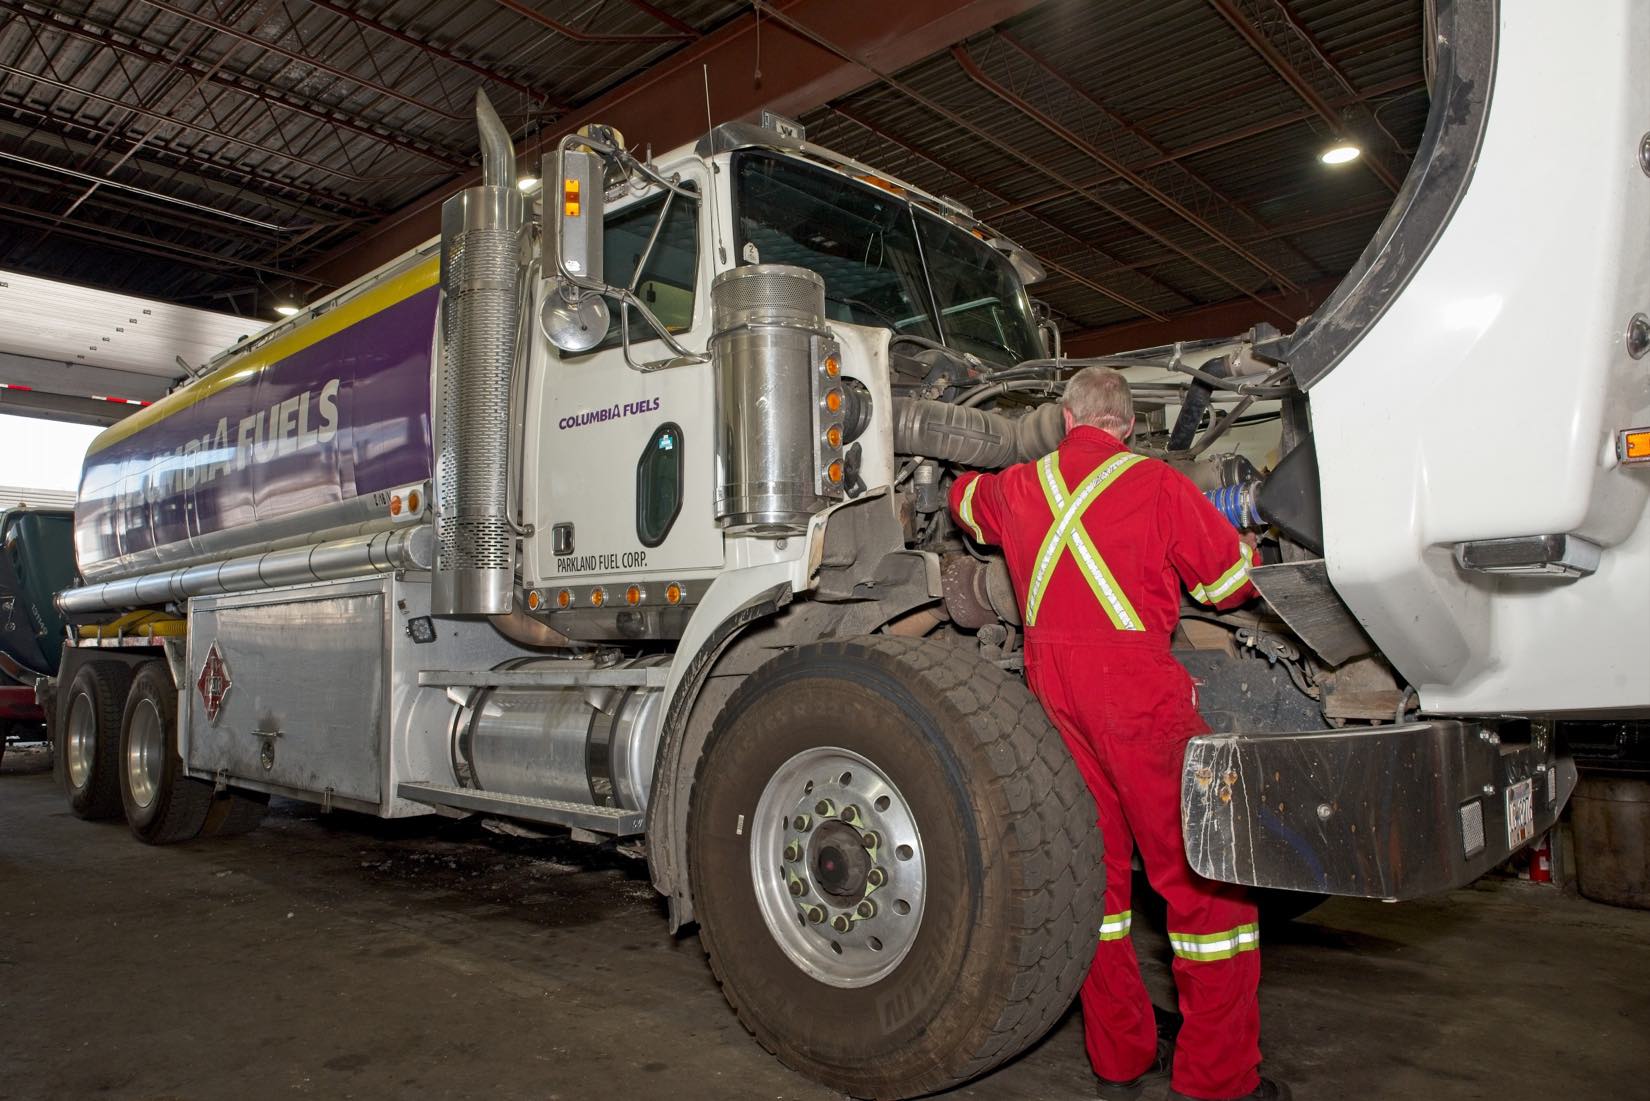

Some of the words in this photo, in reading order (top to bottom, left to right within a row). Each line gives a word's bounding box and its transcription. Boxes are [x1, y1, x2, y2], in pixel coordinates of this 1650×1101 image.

[236, 378, 340, 472] FUELS
[559, 404, 621, 430] COLUMBIA
[623, 397, 660, 417] FUELS
[557, 555, 597, 574] PARKLAND
[599, 553, 620, 571] FUEL
[622, 551, 648, 569] CORP.
